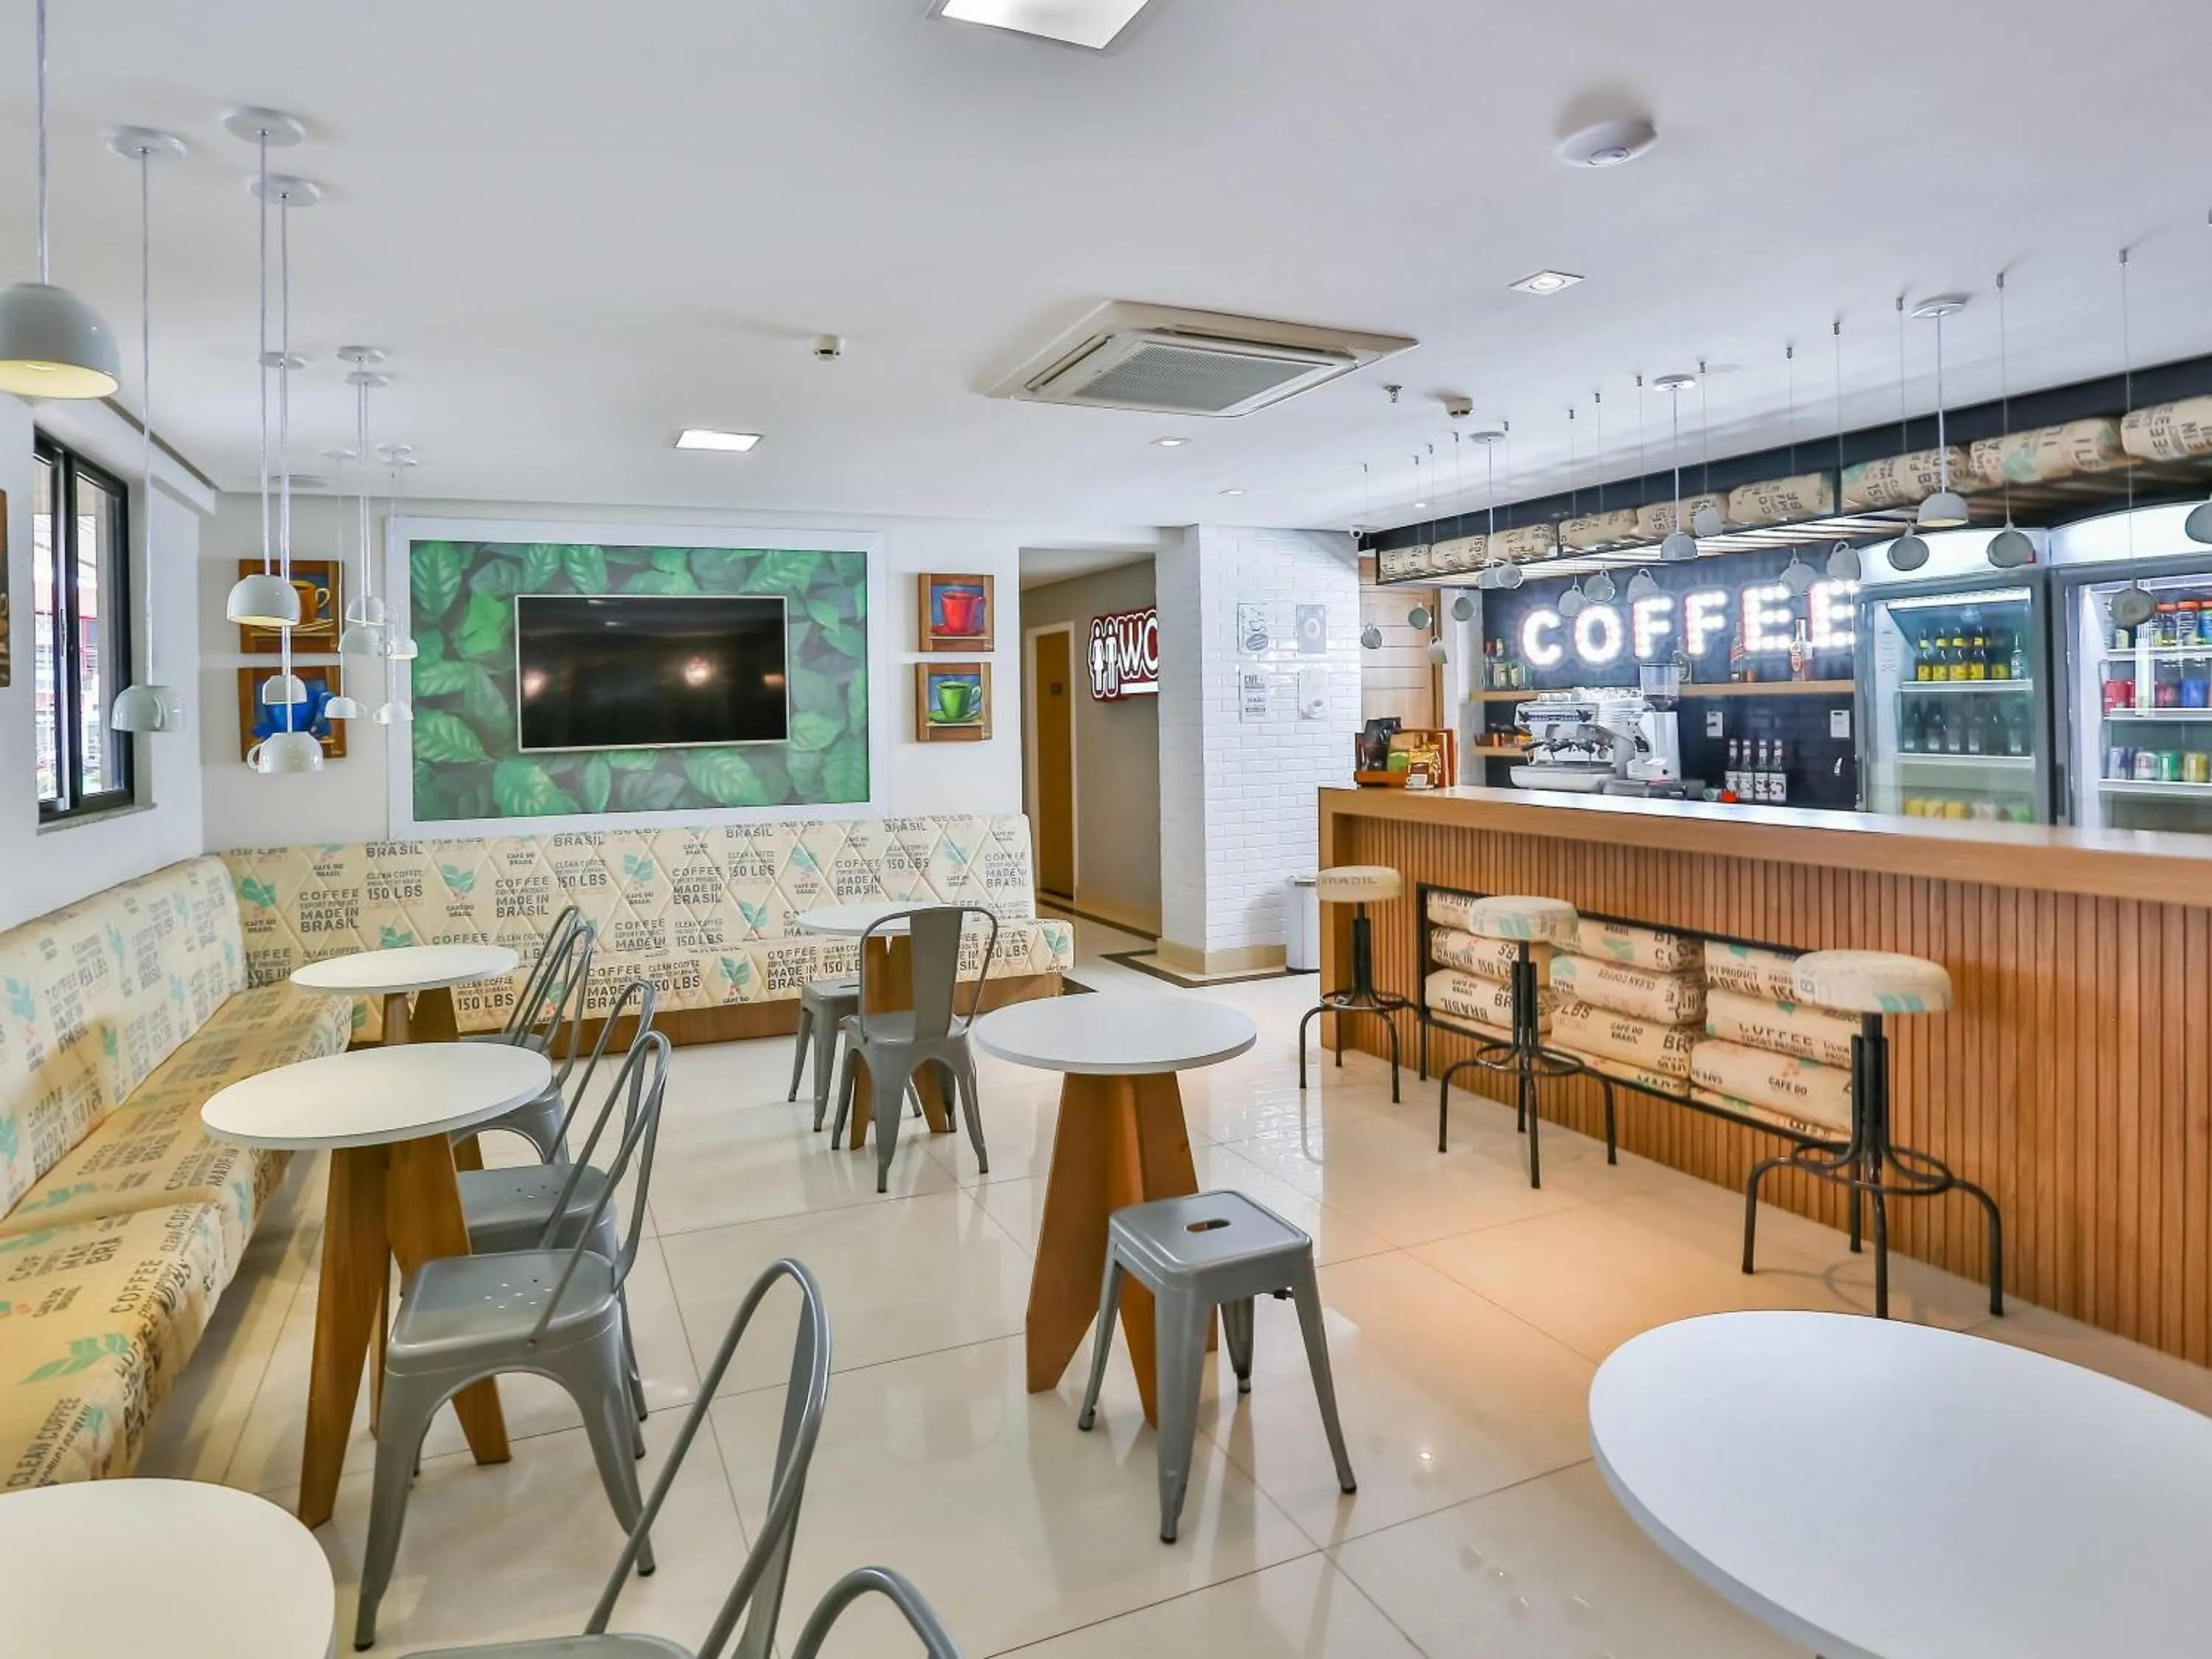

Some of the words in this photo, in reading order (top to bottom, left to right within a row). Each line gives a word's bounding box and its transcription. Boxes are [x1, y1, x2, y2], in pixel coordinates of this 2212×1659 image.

[1521, 580, 1860, 664] COFFEE
[726, 827, 773, 838] BRASIL
[884, 821, 928, 833] BRASIL
[554, 835, 605, 847] BRASIL
[366, 845, 423, 858] BRASIL
[984, 852, 1027, 863] COFFEE
[835, 858, 881, 869] COFFEE
[886, 858, 905, 870] 150
[908, 857, 930, 869] LBS
[672, 866, 723, 877] COFFEE
[751, 864, 776, 877] LBS
[986, 868, 1015, 878] MADE
[495, 876, 549, 888] COFFEE
[557, 875, 576, 889] 150
[580, 873, 608, 886] LBS
[837, 875, 869, 886] MADE
[870, 874, 882, 885] IN
[986, 877, 1028, 889] BRASIL
[299, 888, 359, 901] COFFEE
[366, 887, 390, 900] 150
[394, 884, 423, 899] LBS
[673, 883, 709, 894] MADE
[711, 883, 723, 892] IN
[837, 885, 881, 897] BRASIL
[495, 895, 533, 907] MADE
[536, 894, 549, 905] IN
[673, 893, 723, 905] BRASIL
[300, 908, 341, 921] MADE
[345, 907, 359, 918] IN
[495, 905, 549, 919] BRASIL
[300, 918, 360, 933] BRASIL
[614, 918, 666, 931] COFFEE
[432, 933, 488, 945] COFFEE
[616, 938, 651, 949] MADE
[654, 936, 666, 947] IN
[676, 935, 696, 947] 150
[698, 933, 724, 945] LBS
[768, 946, 817, 959] COFFEE
[1005, 944, 1029, 958] LBS
[247, 969, 273, 981] ADE
[277, 967, 292, 978] IN
[588, 964, 641, 978] COFFEE
[648, 962, 672, 973] CLEAN
[768, 967, 803, 979] MADE
[806, 964, 817, 975] IN
[824, 961, 843, 974] 150
[457, 979, 481, 990] CLEAN
[484, 975, 514, 987] COFFEE
[673, 975, 701, 990] LBS
[587, 984, 627, 998] MADE
[456, 996, 480, 1012] 150
[484, 992, 514, 1009] LBS
[586, 993, 641, 1010] BRAIL
[1561, 1004, 1593, 1020] LBS
[1631, 1025, 1644, 1036] DO
[1611, 1032, 1638, 1045] BRASIL
[1794, 1084, 1807, 1096] DO
[109, 1259, 164, 1314] COFFEE
[6, 1439, 55, 1487] CLEAN
[35, 1397, 83, 1440] COFFEE
